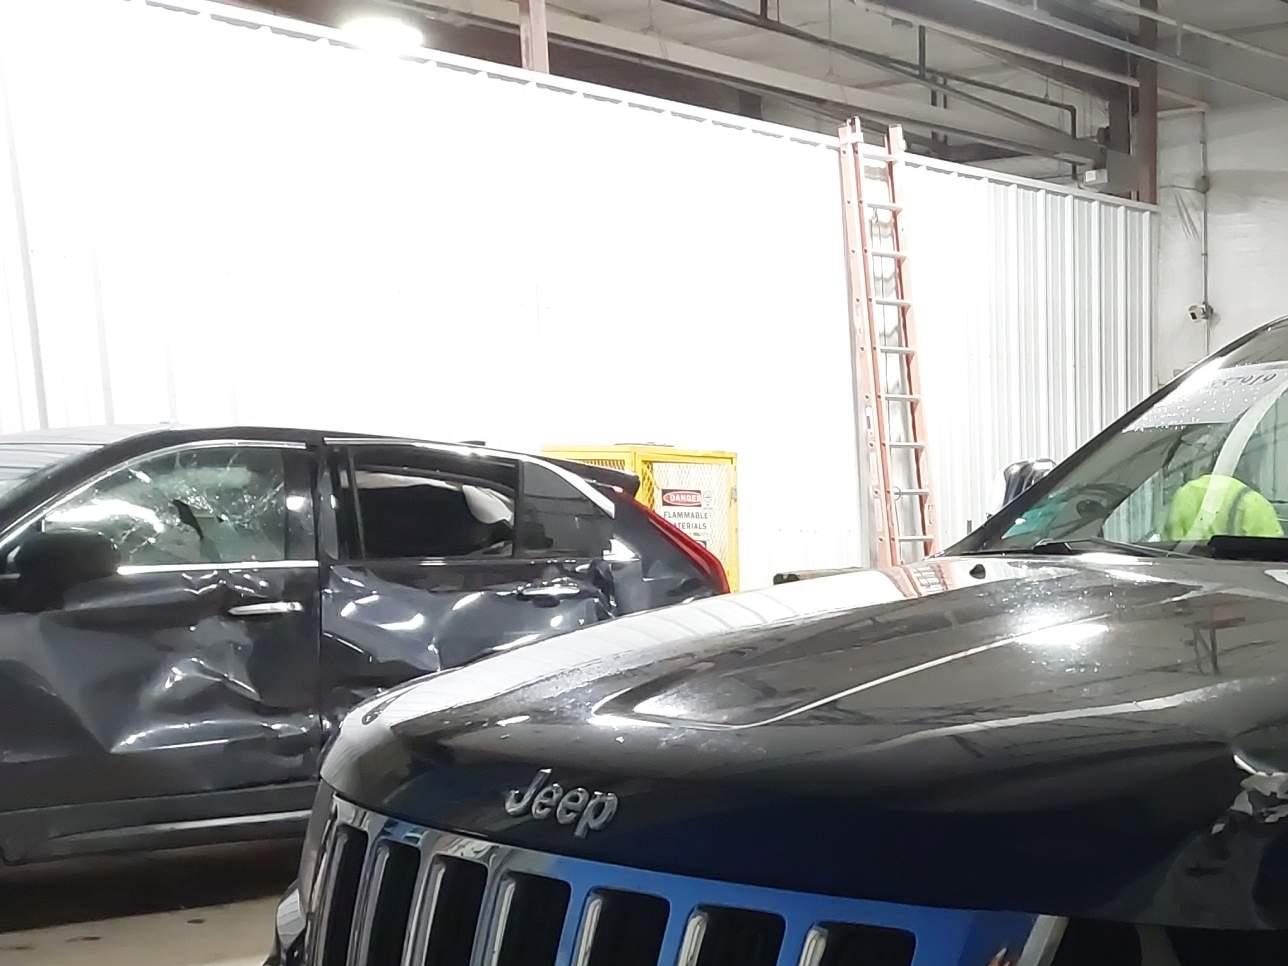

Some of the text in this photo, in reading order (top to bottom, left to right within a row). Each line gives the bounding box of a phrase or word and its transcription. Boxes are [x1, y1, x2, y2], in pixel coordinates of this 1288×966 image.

[663, 511, 708, 519] FLAMMABLE
[673, 522, 707, 530] ATERIALS
[505, 768, 618, 839] Jeep
